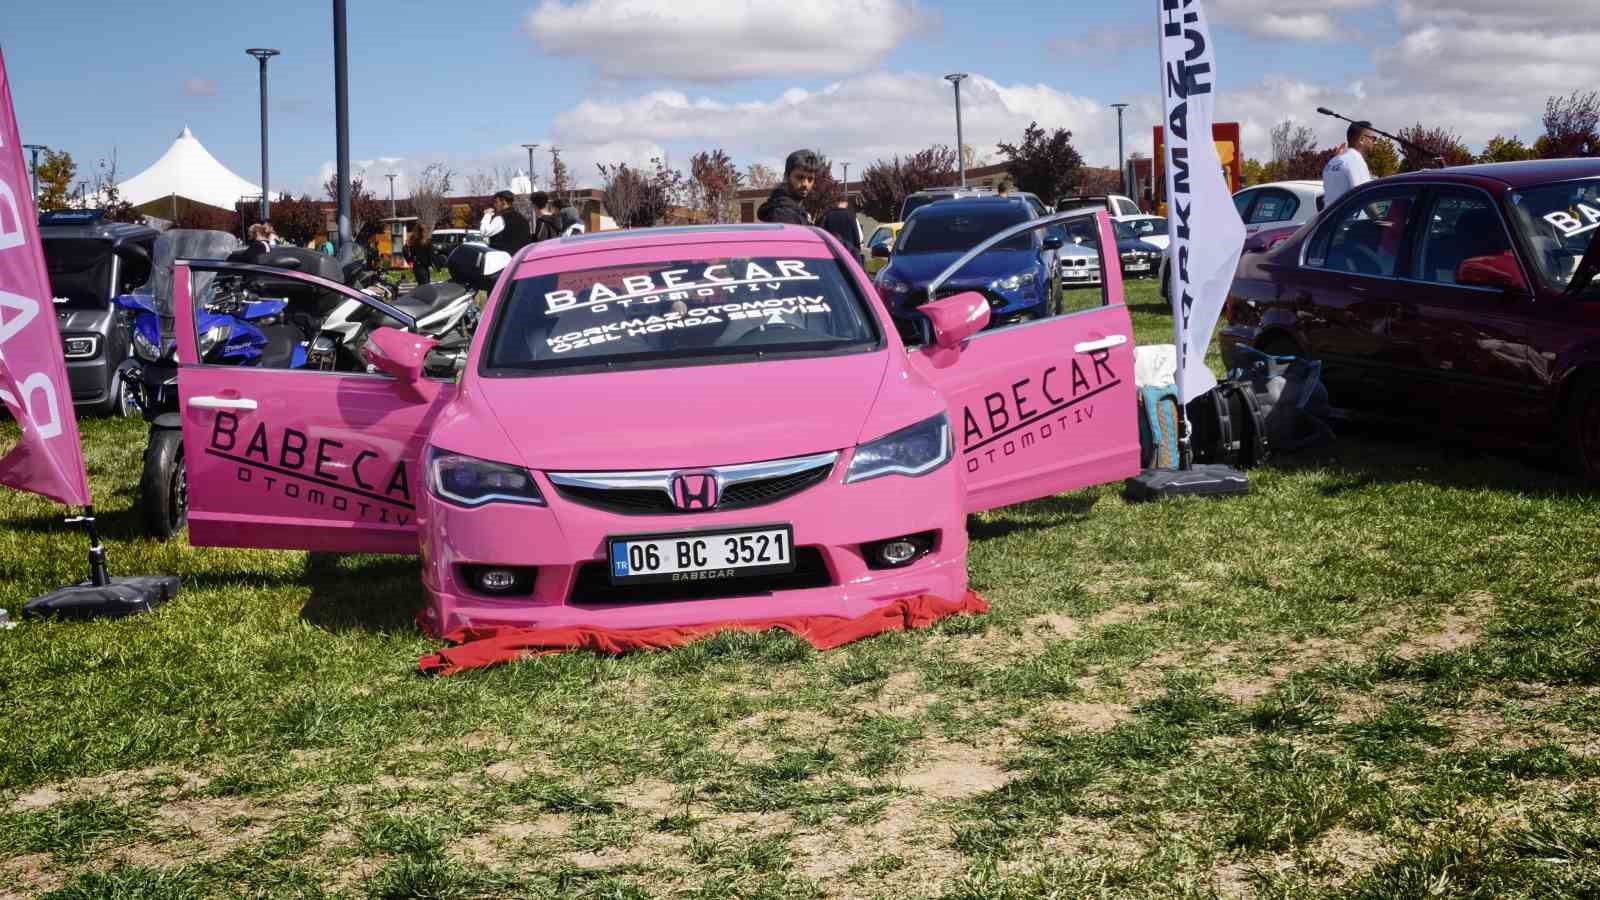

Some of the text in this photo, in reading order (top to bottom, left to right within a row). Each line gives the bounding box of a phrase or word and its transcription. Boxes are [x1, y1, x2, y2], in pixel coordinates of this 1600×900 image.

[1543, 198, 1600, 233] BA
[544, 260, 812, 311] BABECAR
[591, 282, 781, 313] OTOMOTIV
[546, 311, 683, 346] KORKMAZ
[627, 315, 723, 336] HONDA
[963, 348, 1116, 446] ABECAR
[210, 410, 411, 501] BABECA
[966, 404, 1094, 474] OTOMOTIV
[237, 466, 409, 527] OTOMOTIV
[629, 543, 660, 572] 06
[676, 540, 708, 569] BC
[724, 533, 785, 565] 3521
[672, 569, 736, 581] BABECAR
